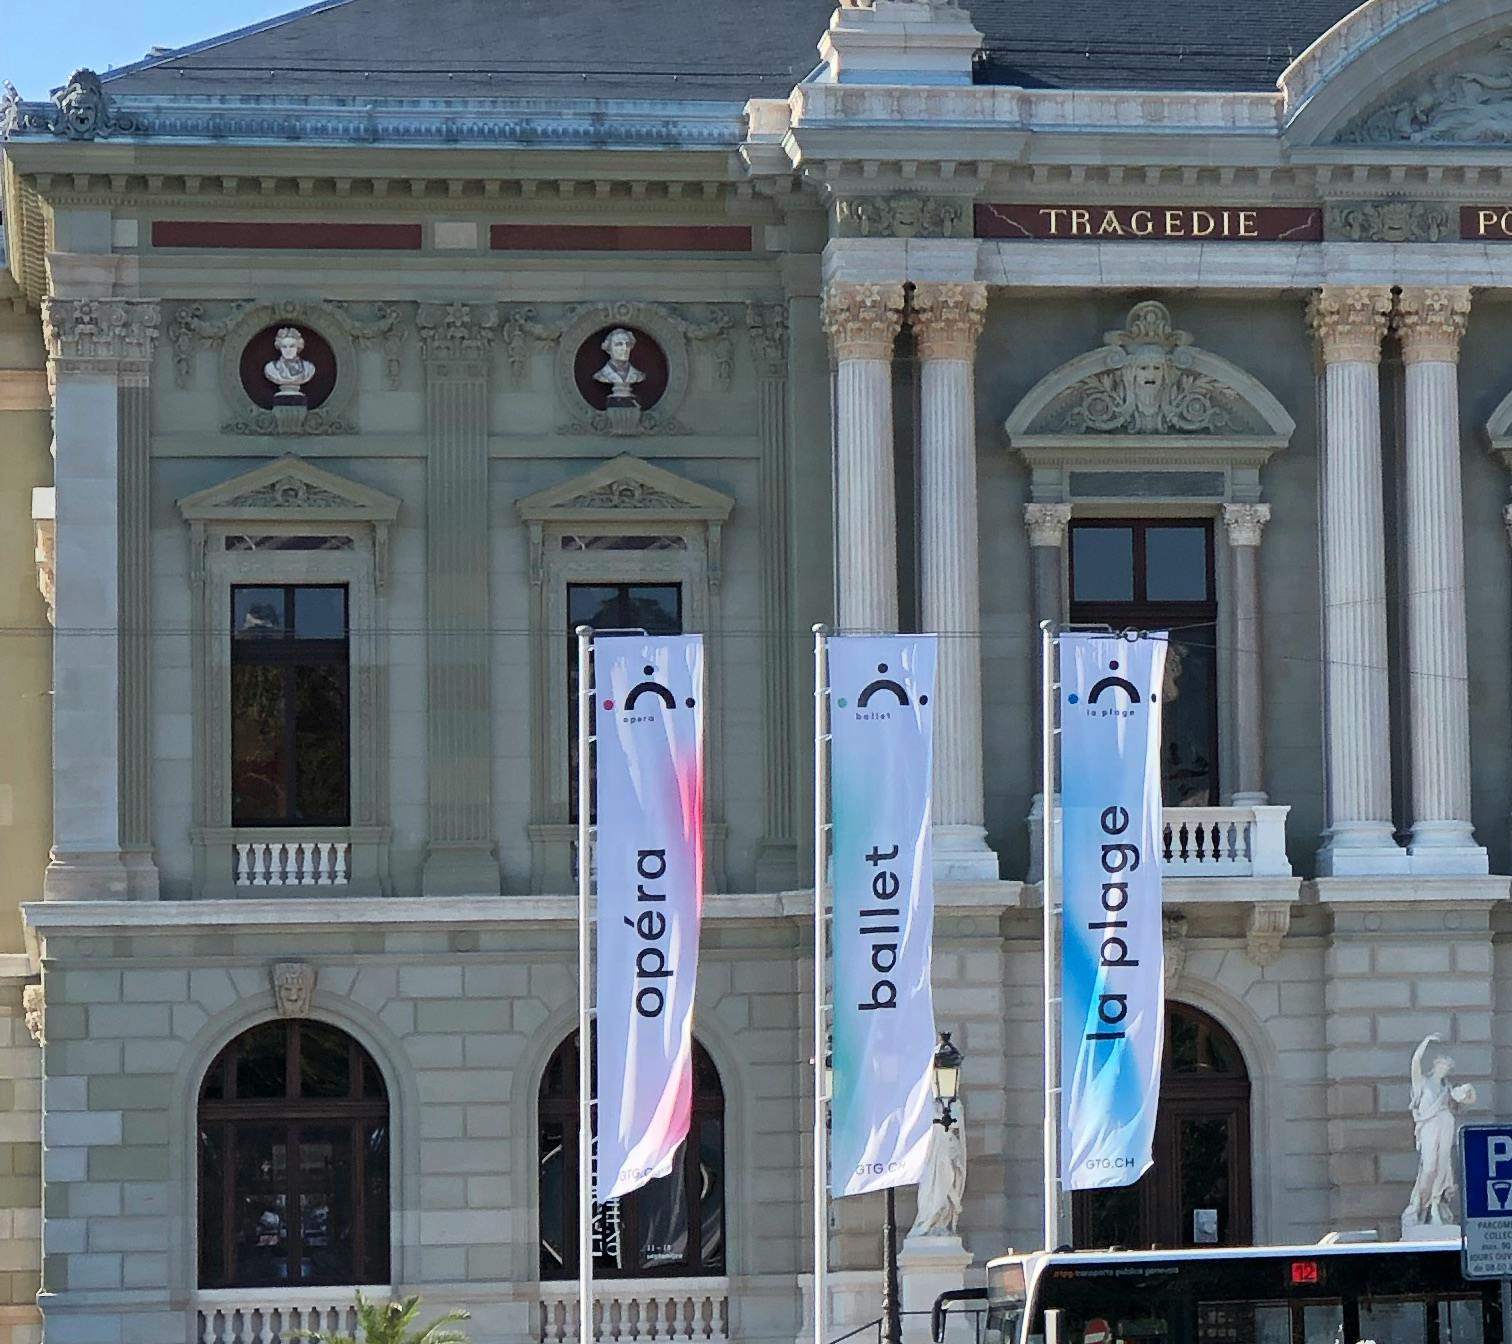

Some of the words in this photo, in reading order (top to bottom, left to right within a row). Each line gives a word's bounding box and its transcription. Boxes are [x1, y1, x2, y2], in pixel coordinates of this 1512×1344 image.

[1039, 209, 1259, 236] TRAGEDIE
[1088, 805, 1140, 967] plage
[624, 849, 674, 1017] opéra
[858, 844, 900, 1010] ballet
[1086, 994, 1128, 1041] la
[1086, 1157, 1135, 1169] GTG.CH
[1487, 1135, 1512, 1178] P
[1296, 1265, 1315, 1280] 12
